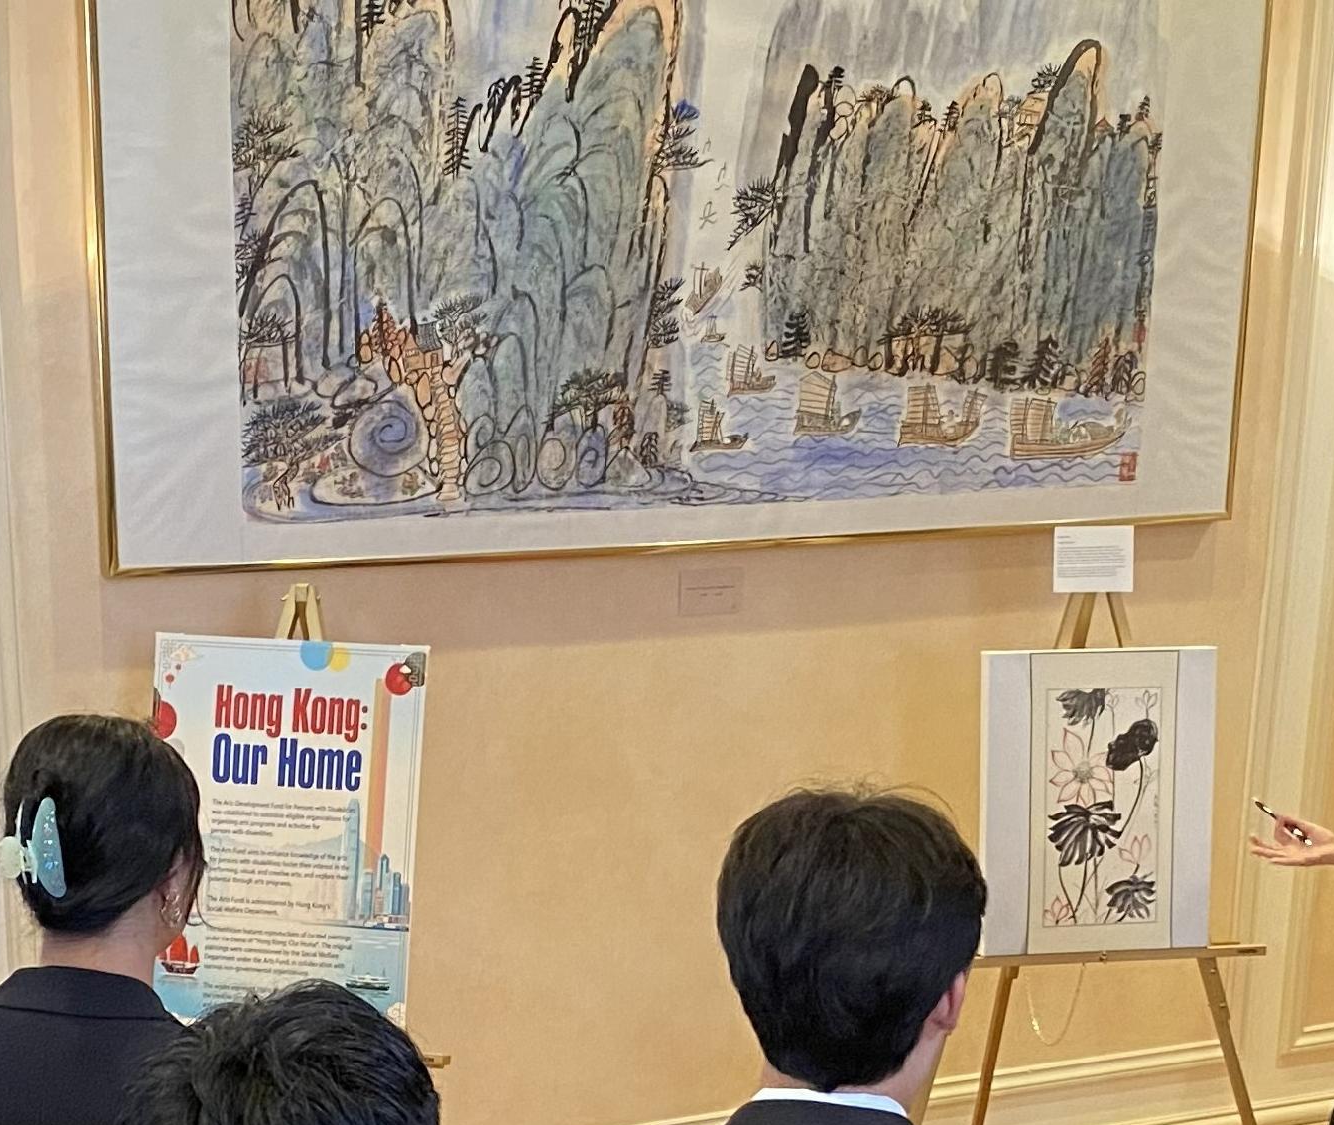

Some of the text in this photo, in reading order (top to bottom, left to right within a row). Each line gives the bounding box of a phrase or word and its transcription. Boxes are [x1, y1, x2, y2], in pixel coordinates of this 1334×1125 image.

[215, 684, 368, 742] Hong Kong:
[212, 733, 362, 792] Our Home
